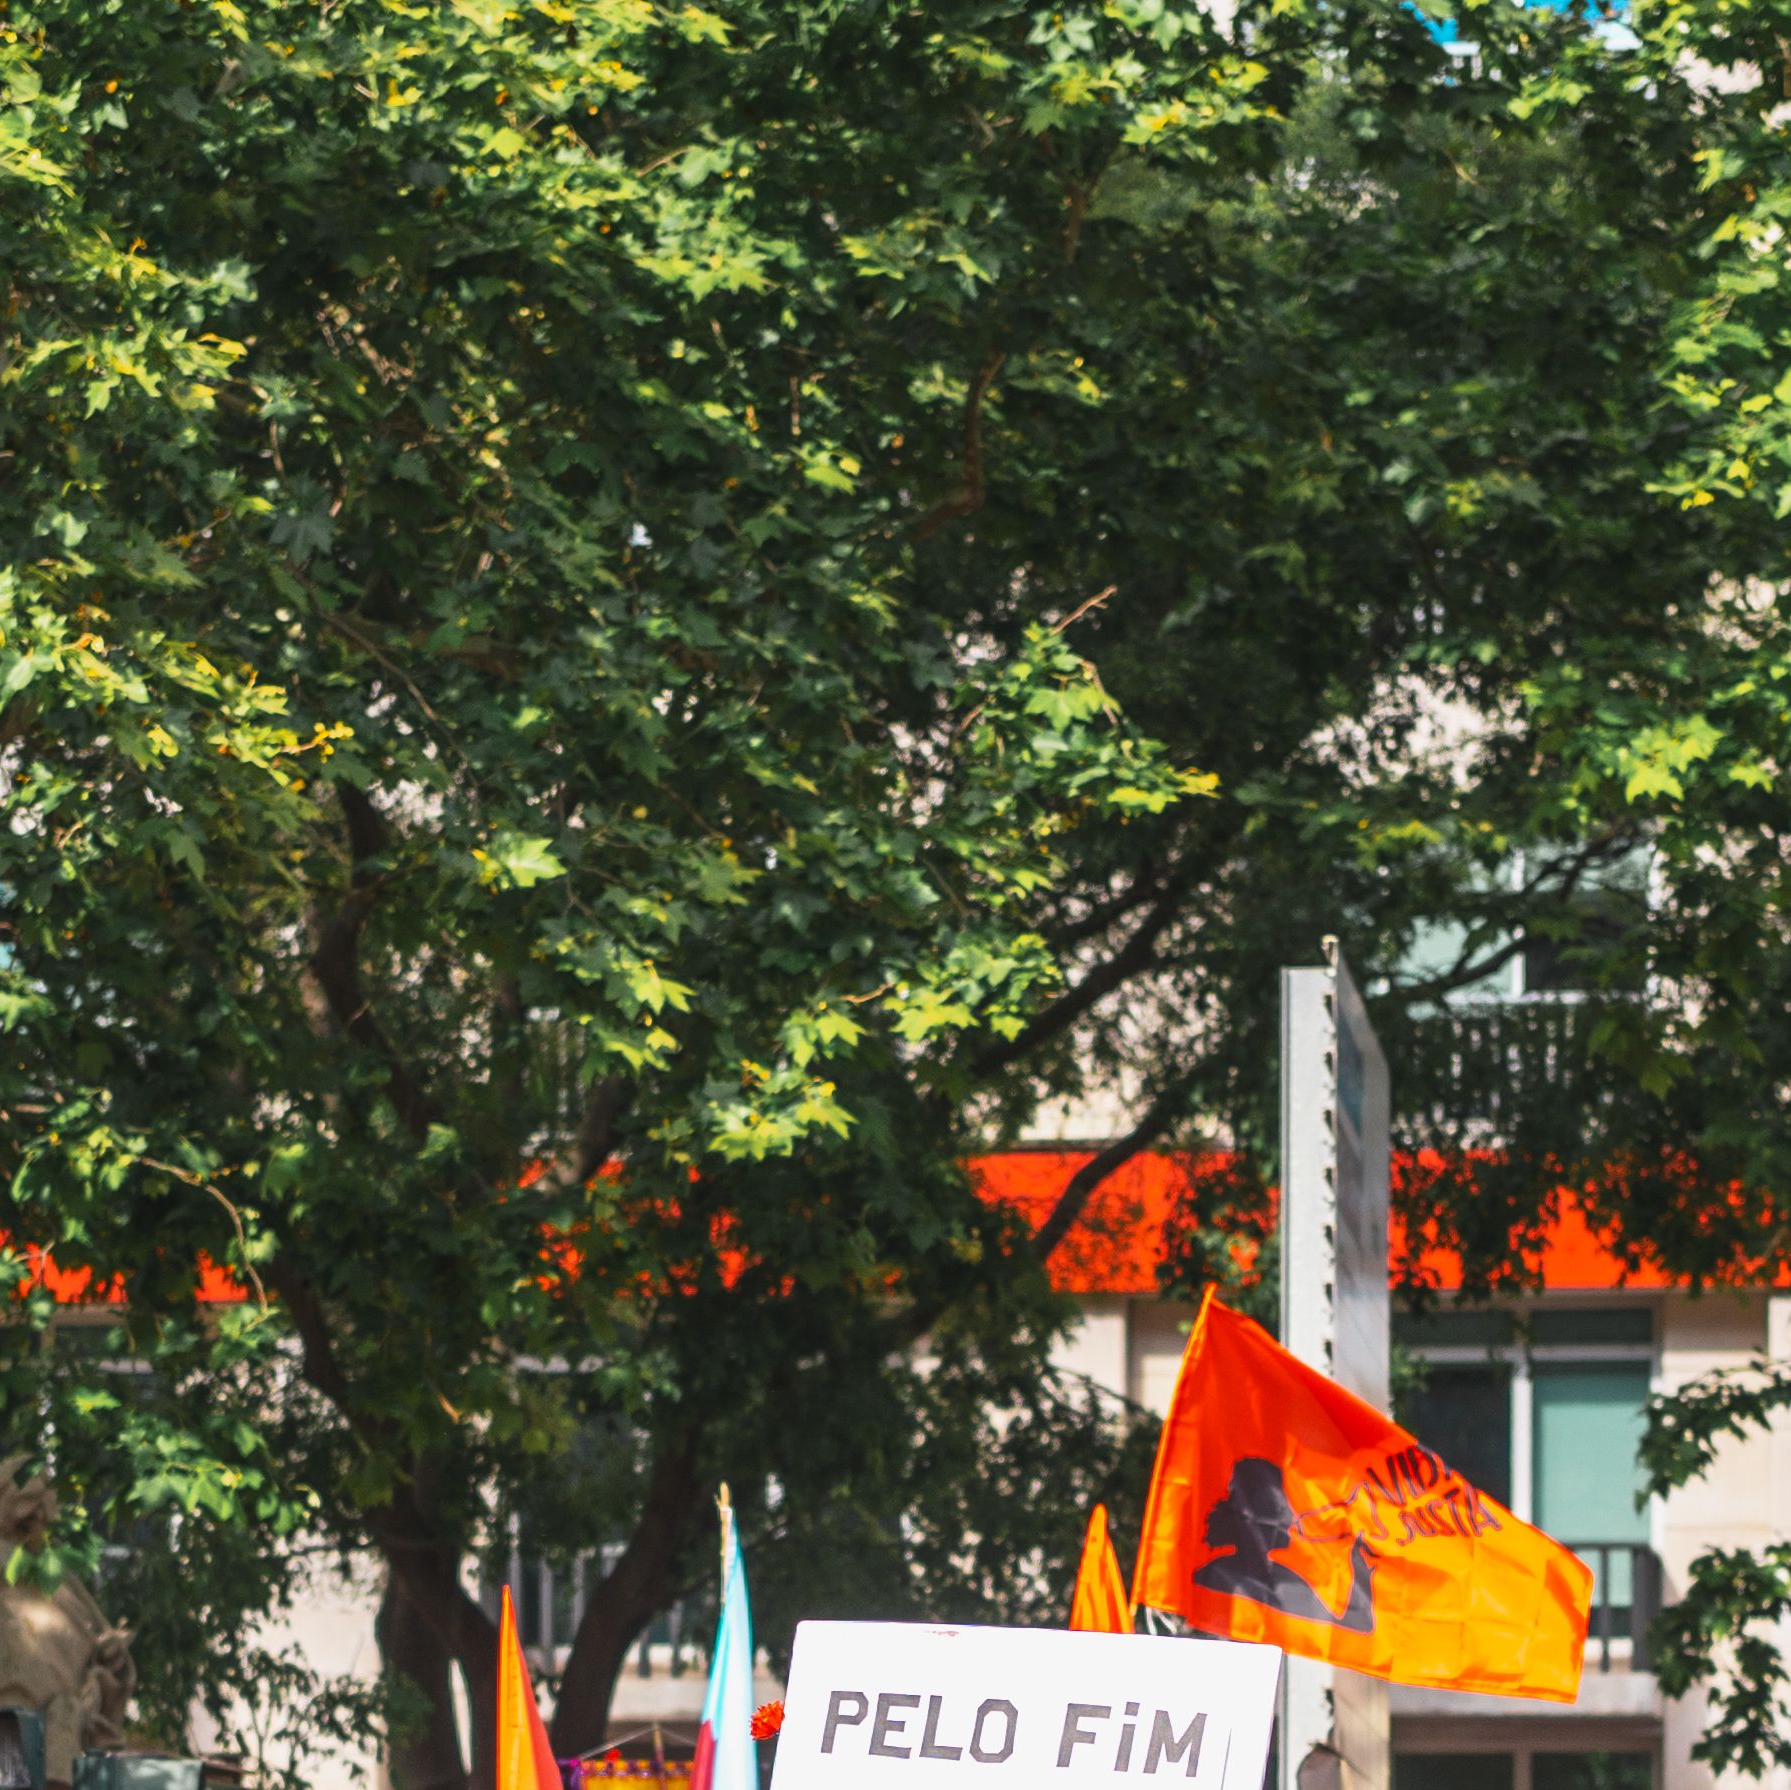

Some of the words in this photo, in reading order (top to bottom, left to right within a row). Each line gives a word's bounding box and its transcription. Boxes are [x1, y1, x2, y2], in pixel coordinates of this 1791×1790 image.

[1366, 1446, 1451, 1505] VID
[1396, 1483, 1502, 1546] JUSTA
[820, 1690, 1019, 1763] PELO
